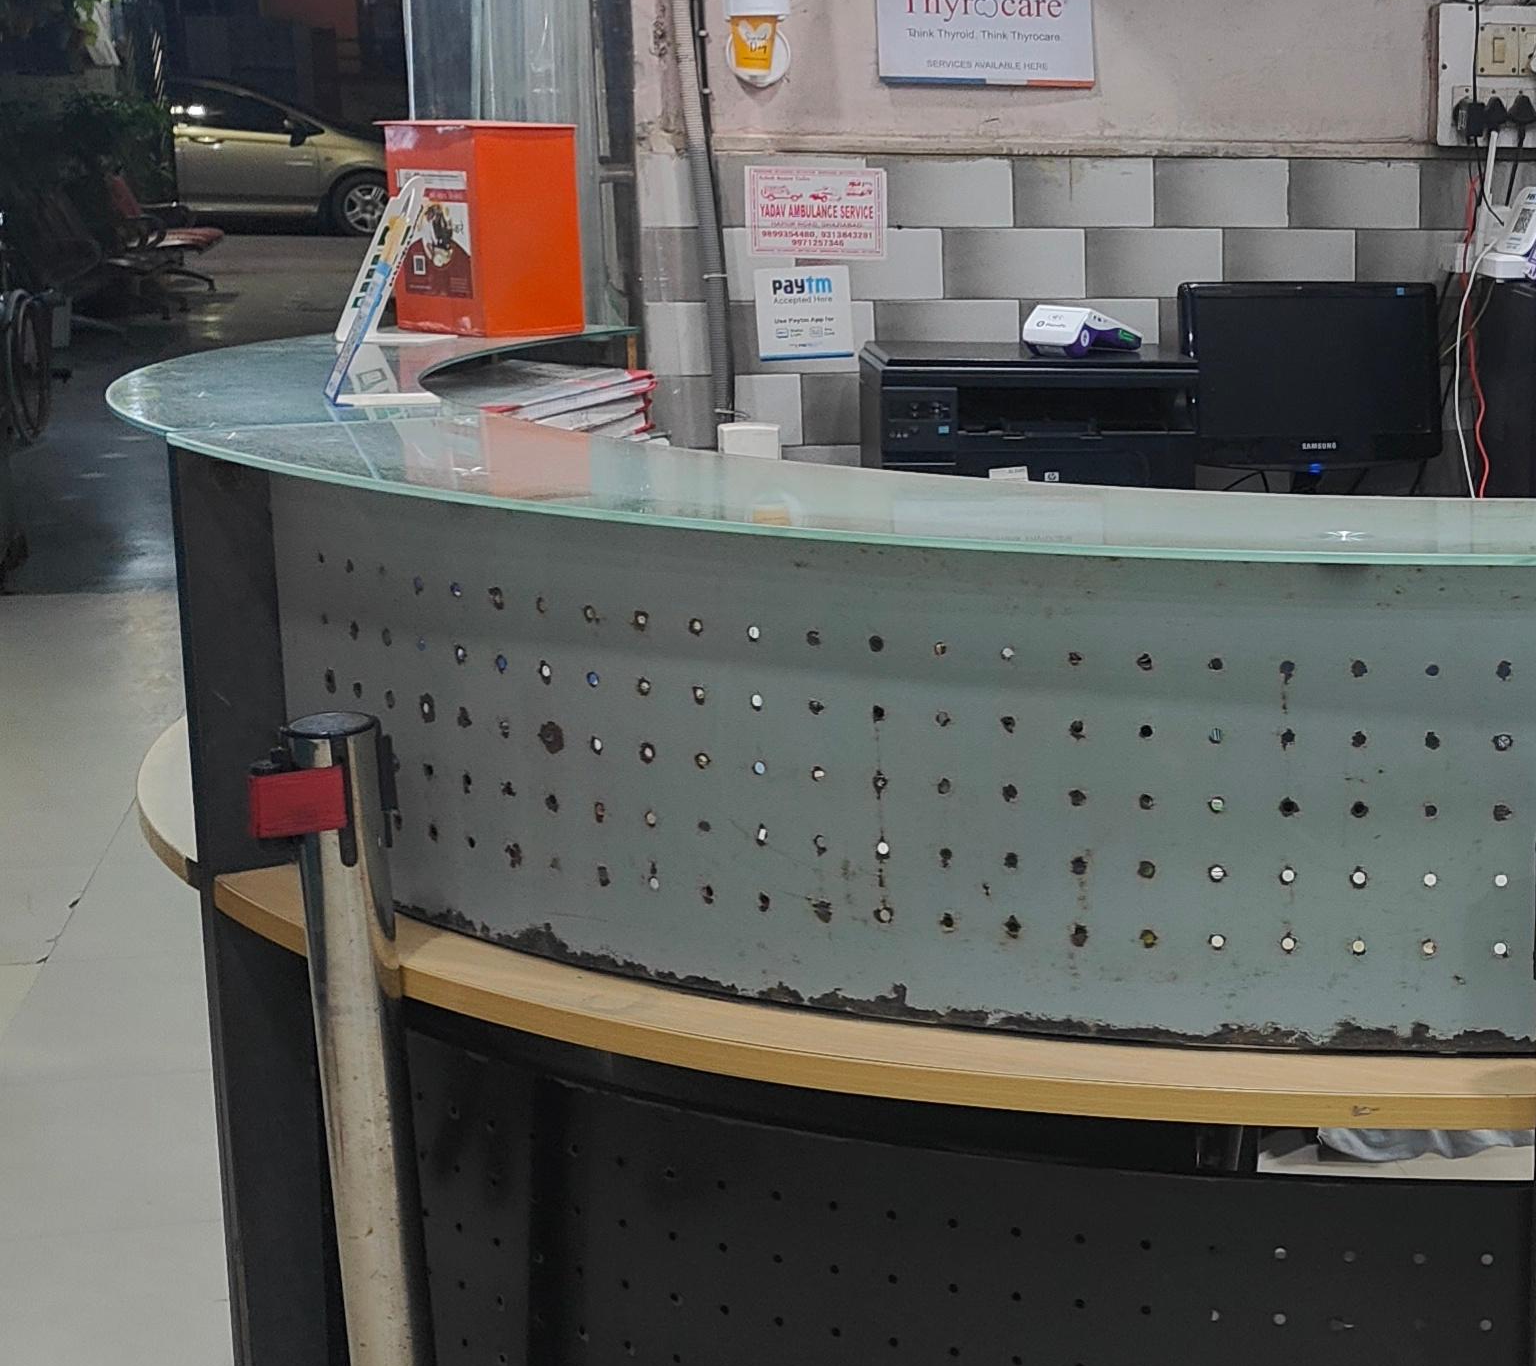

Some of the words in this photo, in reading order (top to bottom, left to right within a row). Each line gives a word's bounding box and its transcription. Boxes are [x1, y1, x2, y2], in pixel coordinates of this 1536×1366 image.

[907, 28, 934, 38] Think
[977, 30, 1008, 40] Think
[926, 59, 973, 69] SERVICES
[974, 61, 1021, 70] AVAILABLE
[1023, 62, 1049, 71] HERE
[760, 203, 786, 218] YADAV
[788, 204, 838, 219] AMBULANCE
[840, 205, 874, 220] SERVICE
[773, 296, 812, 305] Accepted
[1302, 441, 1337, 450] SAMSUNG
